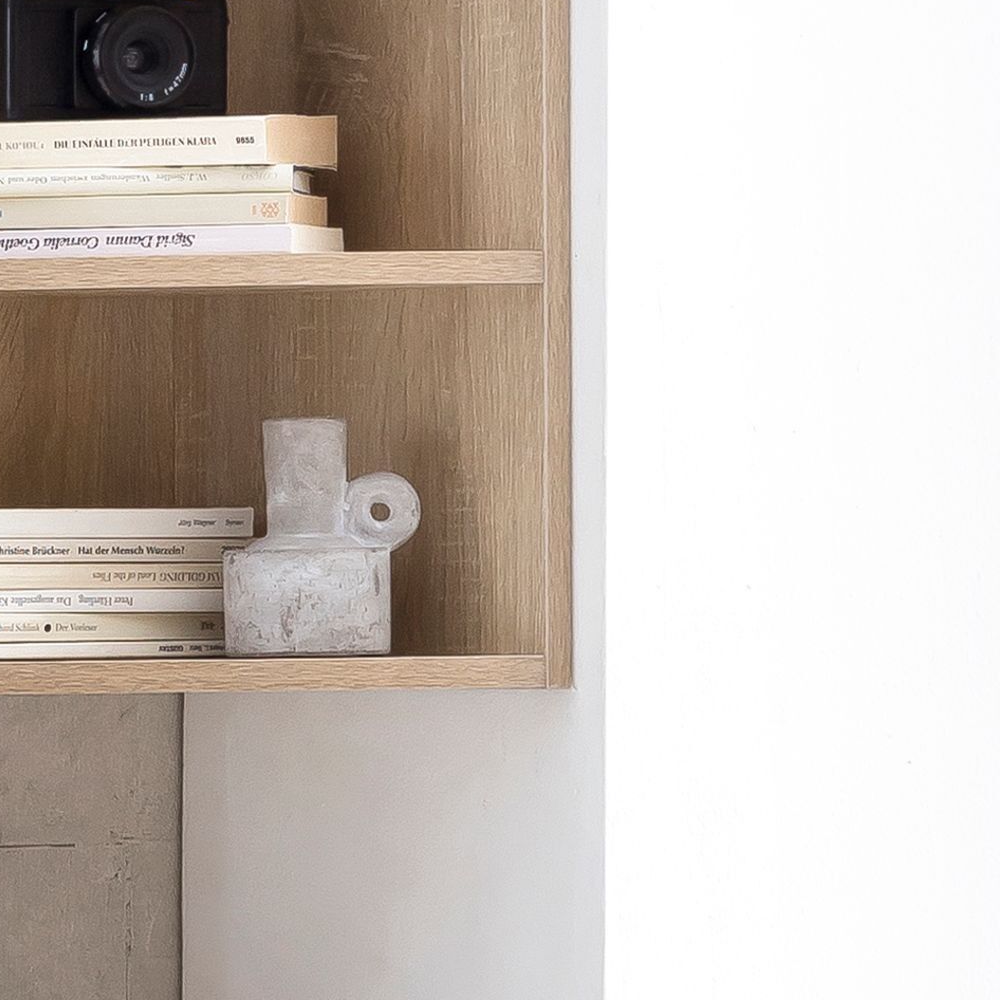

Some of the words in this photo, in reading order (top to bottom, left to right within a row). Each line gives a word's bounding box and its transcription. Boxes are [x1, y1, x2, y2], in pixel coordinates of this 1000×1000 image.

[44, 236, 99, 250] Cornelia
[105, 234, 153, 248] Damm
[156, 232, 195, 249] Sigrid
[32, 546, 70, 555] Brückner
[78, 547, 93, 555] Hat
[95, 546, 109, 554] der
[111, 546, 144, 554] Mensch
[146, 546, 185, 555] Wurzeln?
[92, 573, 111, 582] Flies
[113, 572, 126, 581] the
[127, 572, 136, 581] of
[137, 572, 156, 581] Lord
[160, 572, 206, 581] GOLDING
[56, 597, 71, 606] Das
[114, 597, 133, 606] Peter
[55, 623, 68, 632] Der
